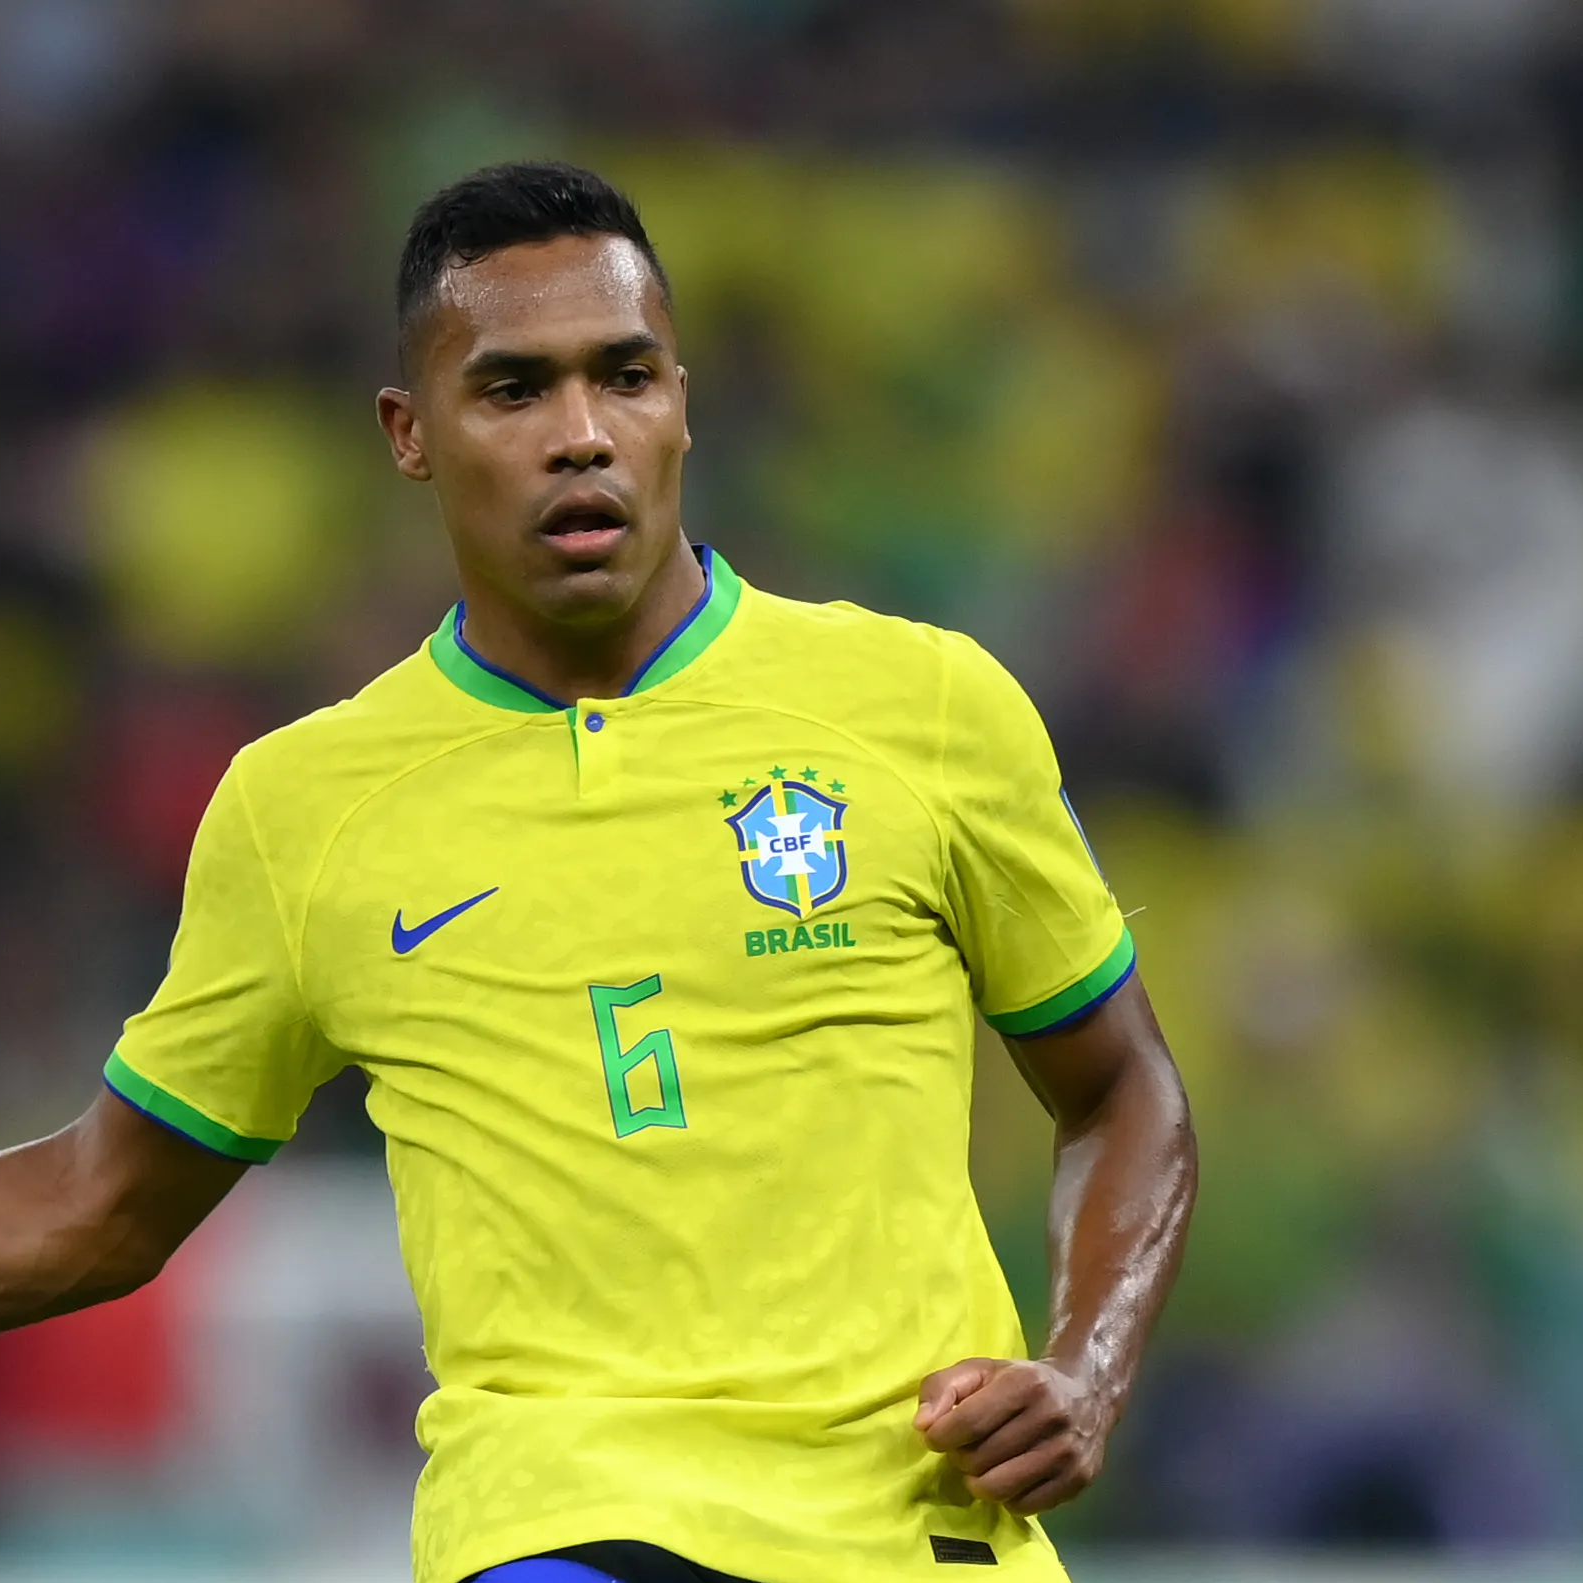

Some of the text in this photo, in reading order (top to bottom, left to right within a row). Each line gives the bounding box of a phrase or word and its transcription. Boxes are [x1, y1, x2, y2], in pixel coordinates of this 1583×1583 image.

[769, 834, 812, 854] CBF
[744, 922, 857, 958] BRASIL
[588, 973, 688, 1139] 6
